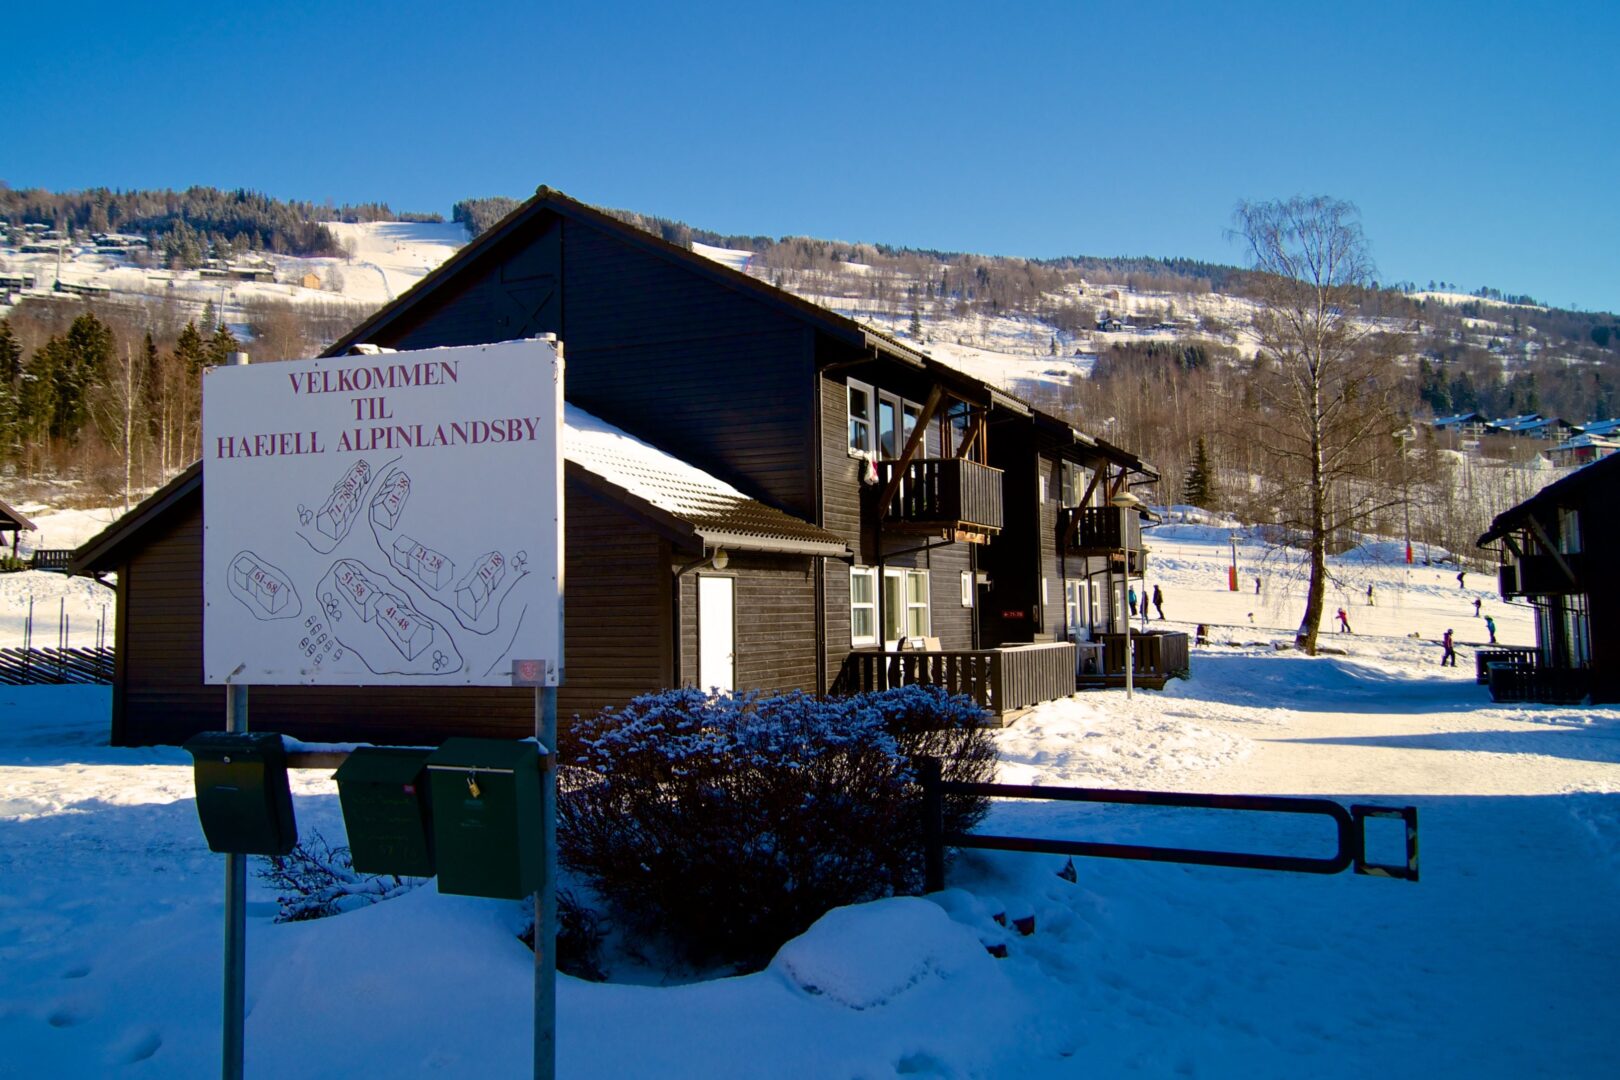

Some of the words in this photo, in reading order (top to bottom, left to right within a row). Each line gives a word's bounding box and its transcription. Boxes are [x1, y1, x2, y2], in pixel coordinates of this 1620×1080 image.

[288, 361, 459, 395] VELKOMMEN
[351, 397, 393, 420] TIL
[216, 431, 325, 458] HAFJELL
[336, 417, 541, 452] ALPINLANDSBY
[389, 478, 408, 507] 31-38
[415, 547, 442, 569] 21-28
[481, 554, 503, 579] 11-18
[254, 571, 279, 593] 61-68
[342, 572, 366, 597] 51-58
[386, 607, 410, 630] 41-48
